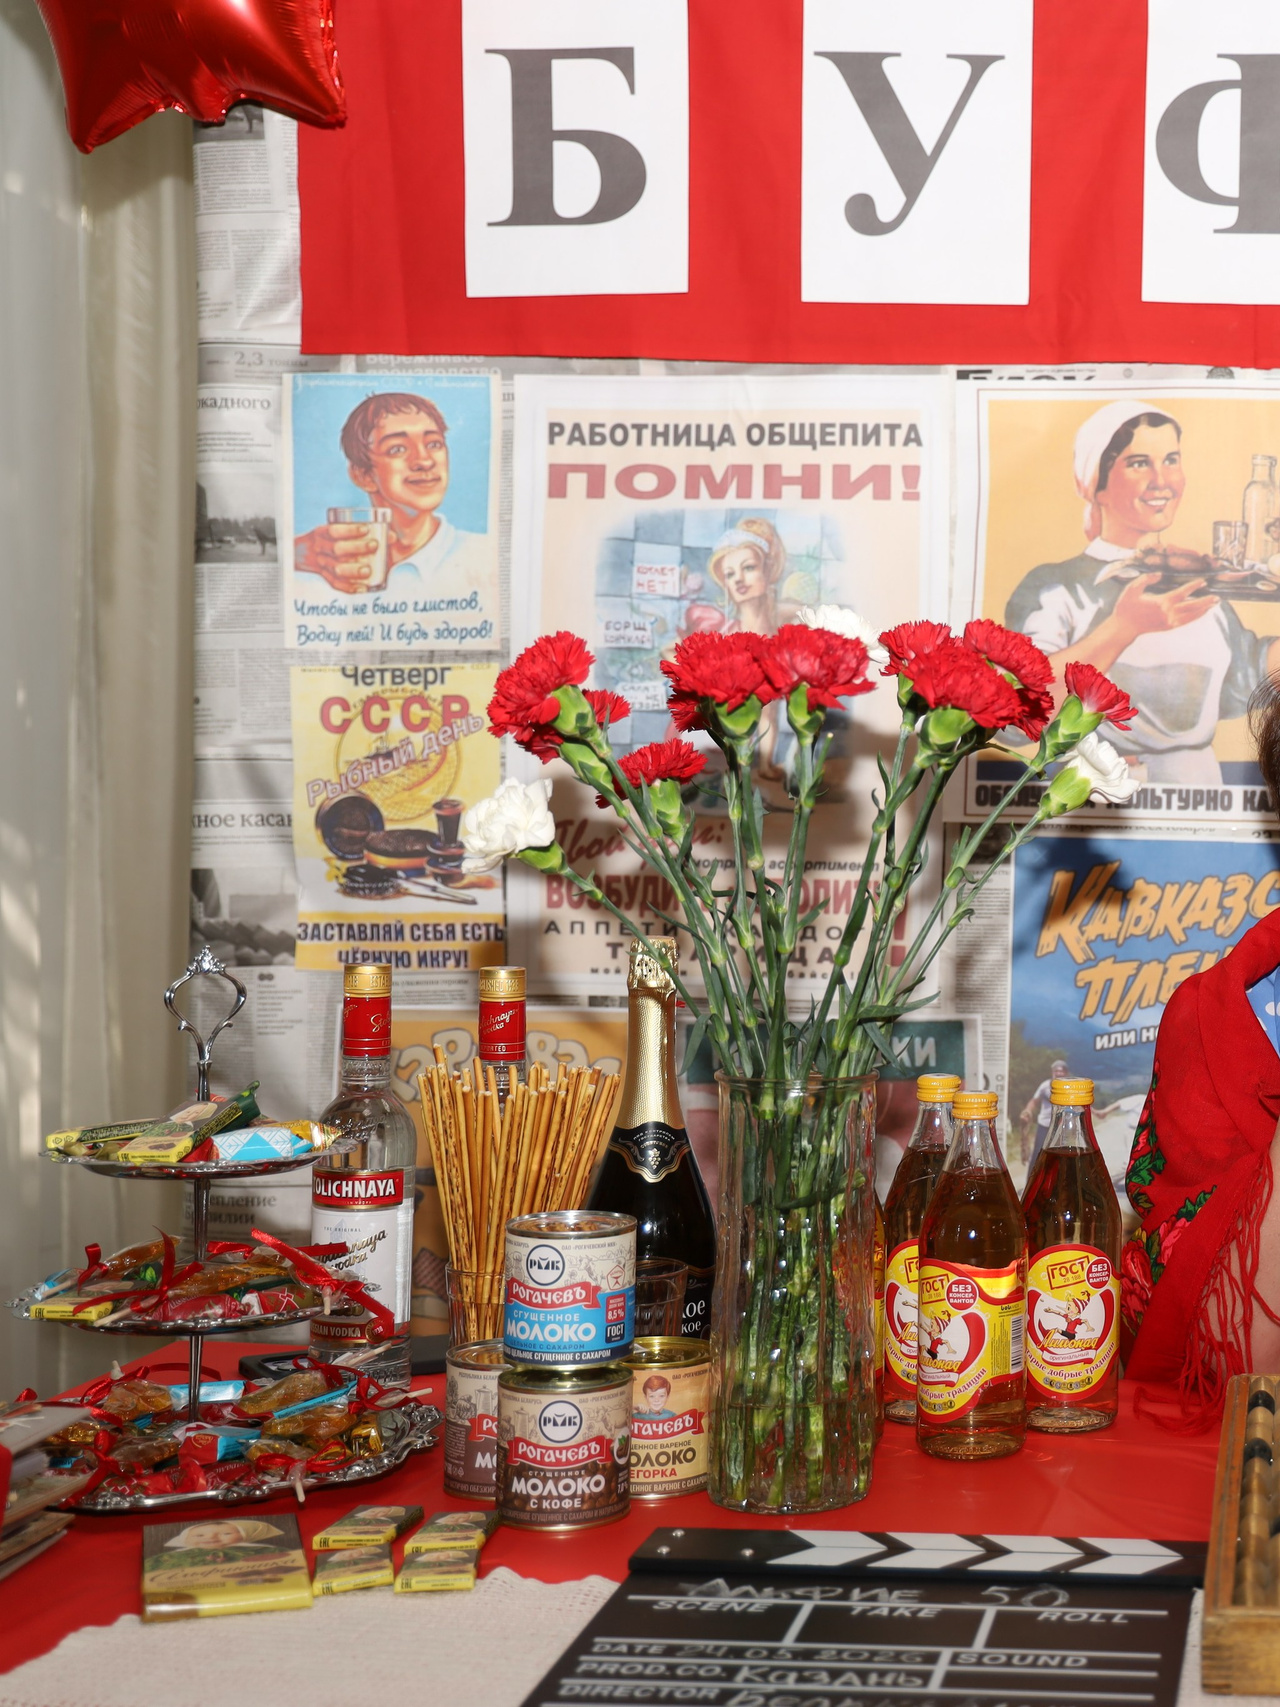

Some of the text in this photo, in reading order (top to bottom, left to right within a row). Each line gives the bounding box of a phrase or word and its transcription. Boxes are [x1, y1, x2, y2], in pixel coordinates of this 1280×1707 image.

[548, 420, 924, 452] РАБОТНИЦА ОБЩЕПИТА
[547, 461, 923, 502] ПОМНИ!
[294, 591, 484, 616] Чтобы не было глистов,
[296, 620, 494, 646] Водку пей! И будь здоров!
[341, 665, 454, 691] Четверг
[319, 694, 470, 735] СССР
[306, 712, 485, 808] Рыбный день
[296, 918, 505, 943] ЗАСТАВЛЯЙ СЕБЯ ЕСТЬ
[544, 920, 678, 937] АППЕТИ
[338, 946, 469, 969] ЧЁРНУЮ ИКРУ!
[313, 1176, 396, 1199] TOLICHNAYA
[1051, 1260, 1086, 1280] ГОСТ
[1091, 1263, 1108, 1273] БЕЗ
[922, 1278, 946, 1294] ГОСТ
[952, 1284, 972, 1293] БЕЗ
[513, 1309, 580, 1322] СГУЩЕННОЕ
[330, 1326, 361, 1338] VODKA
[506, 1318, 596, 1343] МОЛОКО
[606, 1323, 624, 1338] ГОСТ
[1037, 1329, 1100, 1349] Лимонад
[510, 1340, 537, 1350] ЦЕЛЬНОЕ
[546, 1342, 585, 1350] САХАРОМ
[534, 1351, 574, 1362] СГУЩЕННОЕ
[581, 1349, 611, 1361] САХАРОМ
[1047, 1341, 1115, 1380] добрые традиции
[946, 1367, 987, 1399] традиции
[631, 1413, 694, 1436] ГАЧЕВЪ
[659, 1440, 692, 1449] ВАРЕНОЕ
[630, 1447, 697, 1468] ОЛОКО
[630, 1468, 678, 1479] ЕГОРКА
[511, 1474, 606, 1496] МОЛОКО
[653, 1481, 681, 1492] ВАРЕНОЕ
[530, 1497, 582, 1510] С КОФЕ
[651, 1600, 774, 1613] SCENE
[850, 1606, 942, 1619] TAKE
[1036, 1610, 1130, 1624] ROLL
[591, 1642, 667, 1655] DATE
[956, 1652, 1088, 1668] SOUND
[575, 1661, 727, 1677] PROD.CO.
[558, 1683, 721, 1700] DIRECTOR
